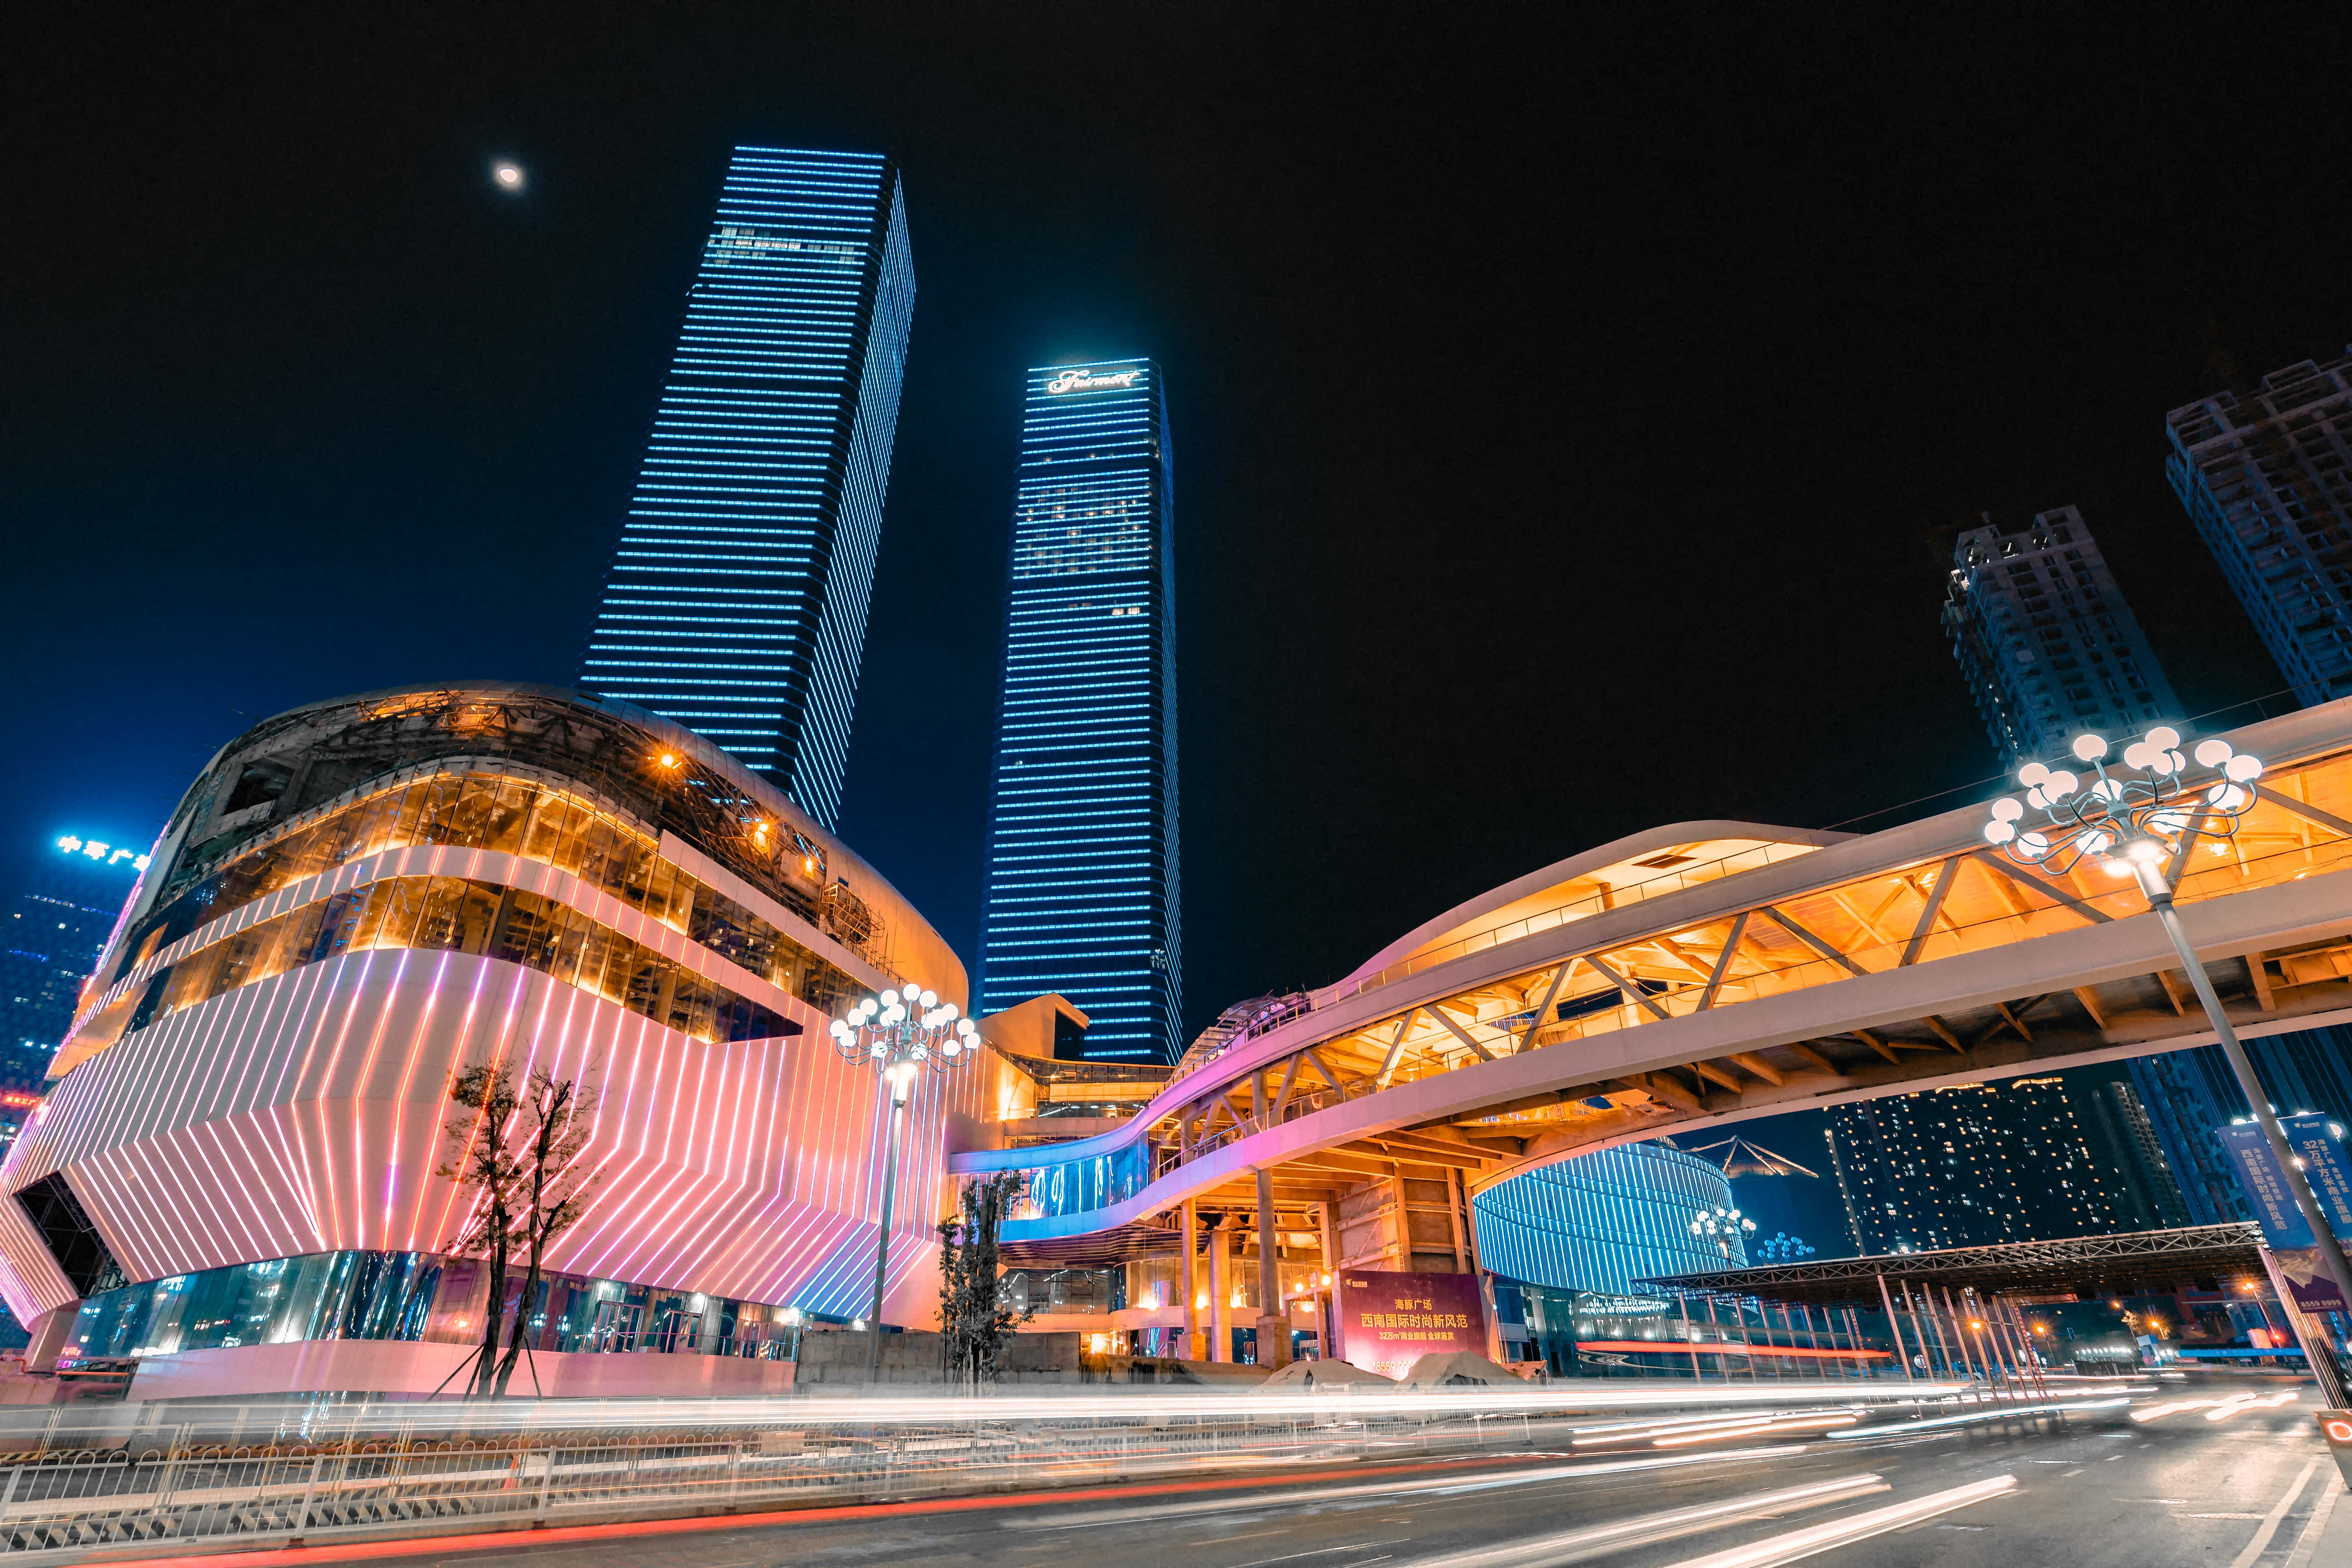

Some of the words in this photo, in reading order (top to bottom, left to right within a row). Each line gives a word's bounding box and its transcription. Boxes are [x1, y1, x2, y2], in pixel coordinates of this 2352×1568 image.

[1049, 370, 1140, 393] Fairmont
[2239, 1149, 2288, 1230] 西南国际时尚新风范
[1394, 1299, 1432, 1310] 海豚广场
[1361, 1313, 1468, 1328] 西南国际时尚新风范
[1428, 1331, 1454, 1340] 全球鉴赏
[1376, 1361, 1396, 1371] 8559
